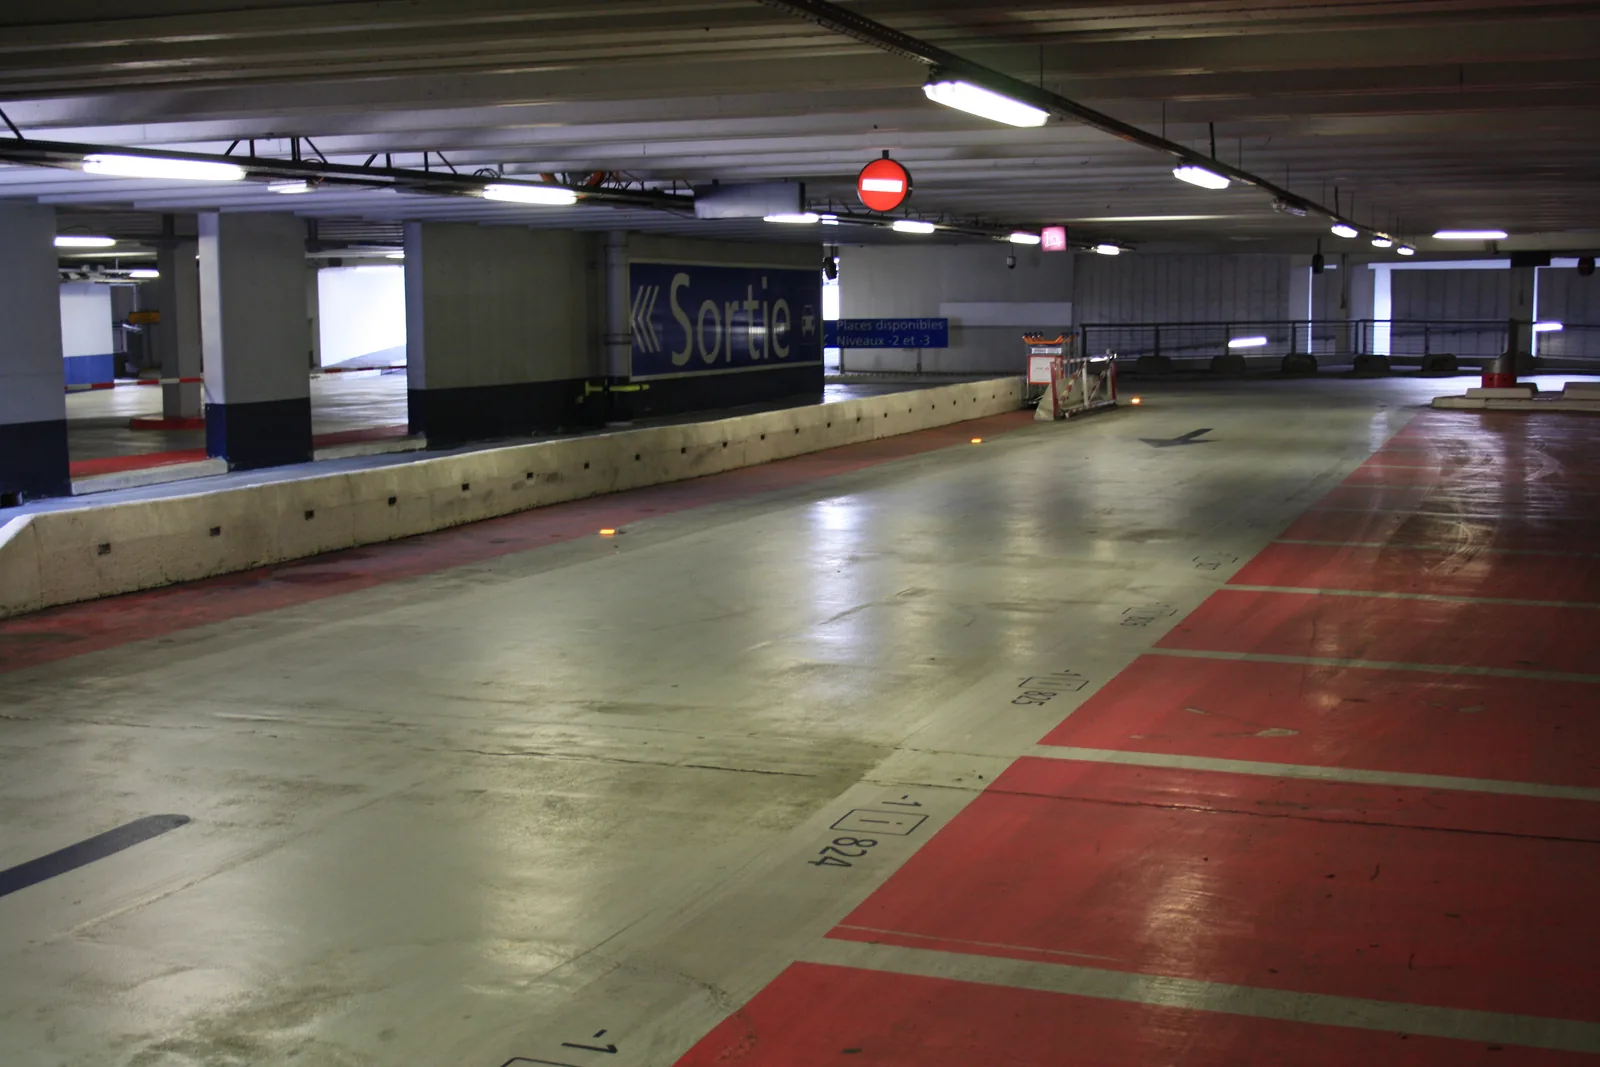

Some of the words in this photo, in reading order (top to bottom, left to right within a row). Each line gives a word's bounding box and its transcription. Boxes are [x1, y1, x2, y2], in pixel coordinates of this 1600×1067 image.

[671, 272, 790, 365] Sortie
[837, 319, 872, 331] Places
[876, 319, 944, 333] disponibles
[837, 335, 884, 345] Niveaux
[888, 335, 899, 346] -2
[903, 336, 915, 346] et
[919, 336, 931, 346] -3
[1011, 690, 1056, 705] 825
[808, 836, 878, 868] 824
